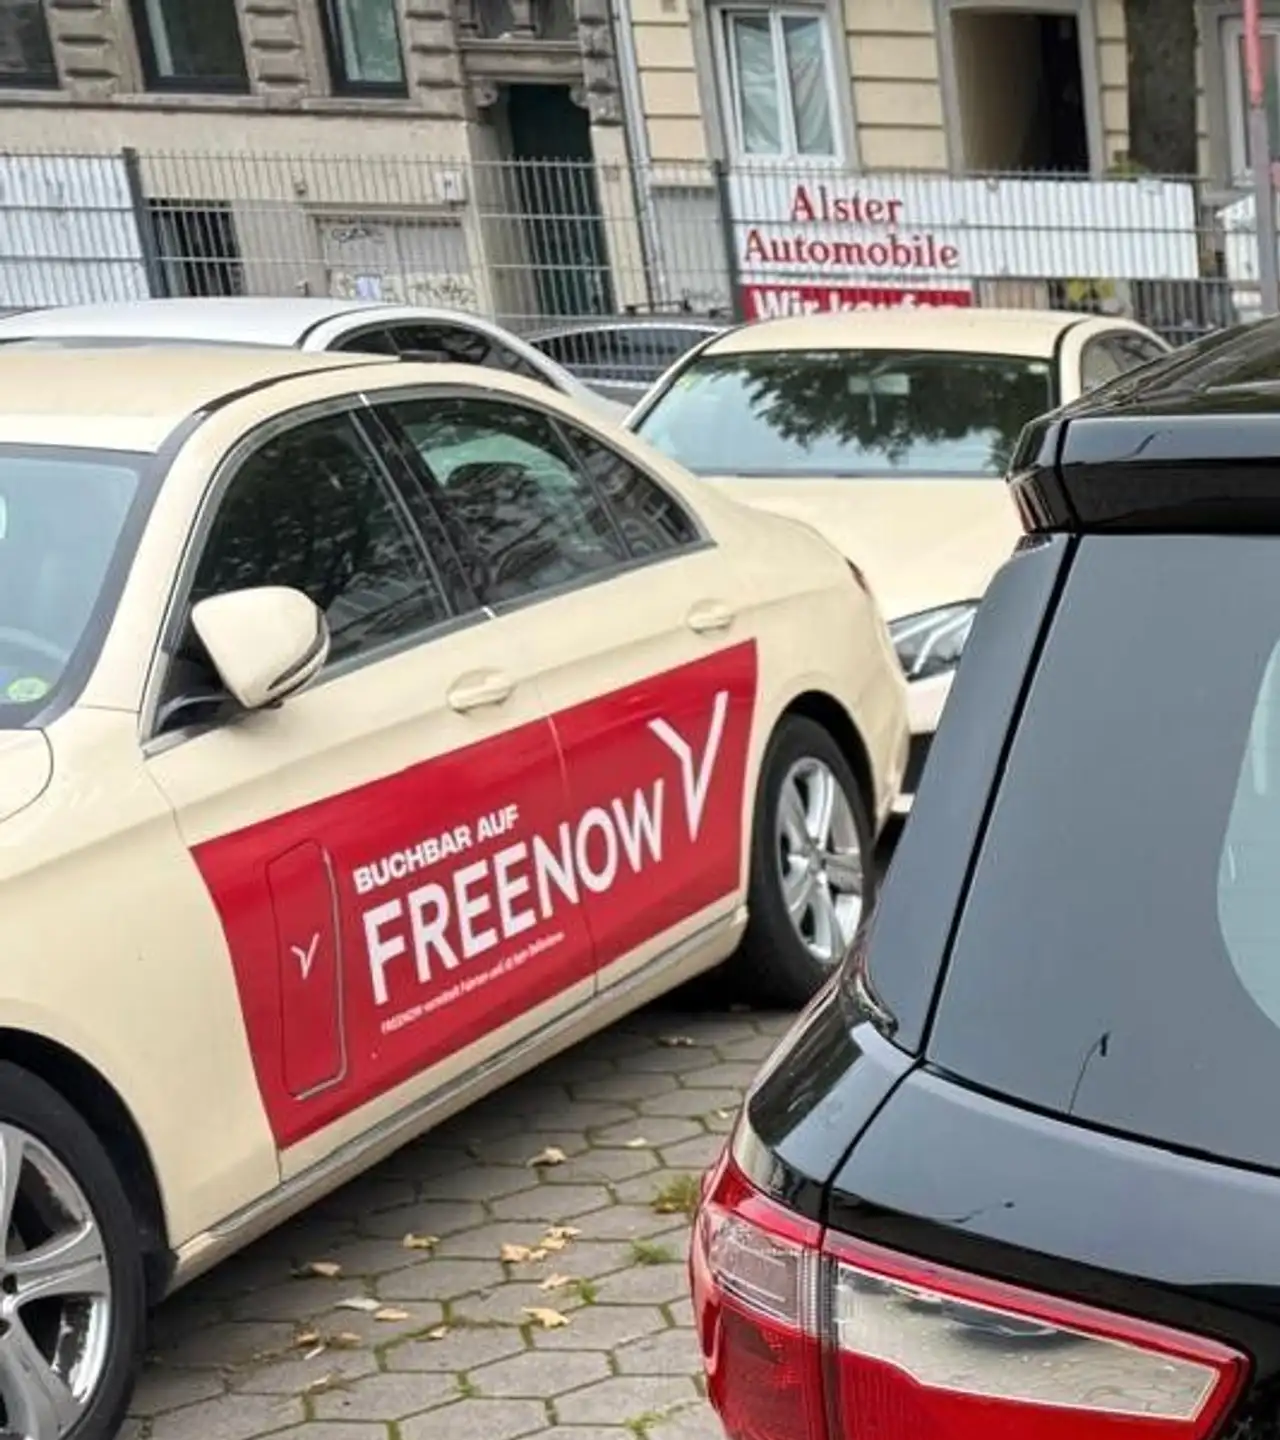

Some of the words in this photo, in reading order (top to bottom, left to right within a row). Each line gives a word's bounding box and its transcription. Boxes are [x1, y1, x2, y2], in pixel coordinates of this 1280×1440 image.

[789, 185, 904, 225] Alster
[743, 229, 961, 271] Automobile
[352, 824, 474, 895] BUCHBAR
[475, 804, 521, 843] AUF
[361, 777, 665, 1006] FREENOW
